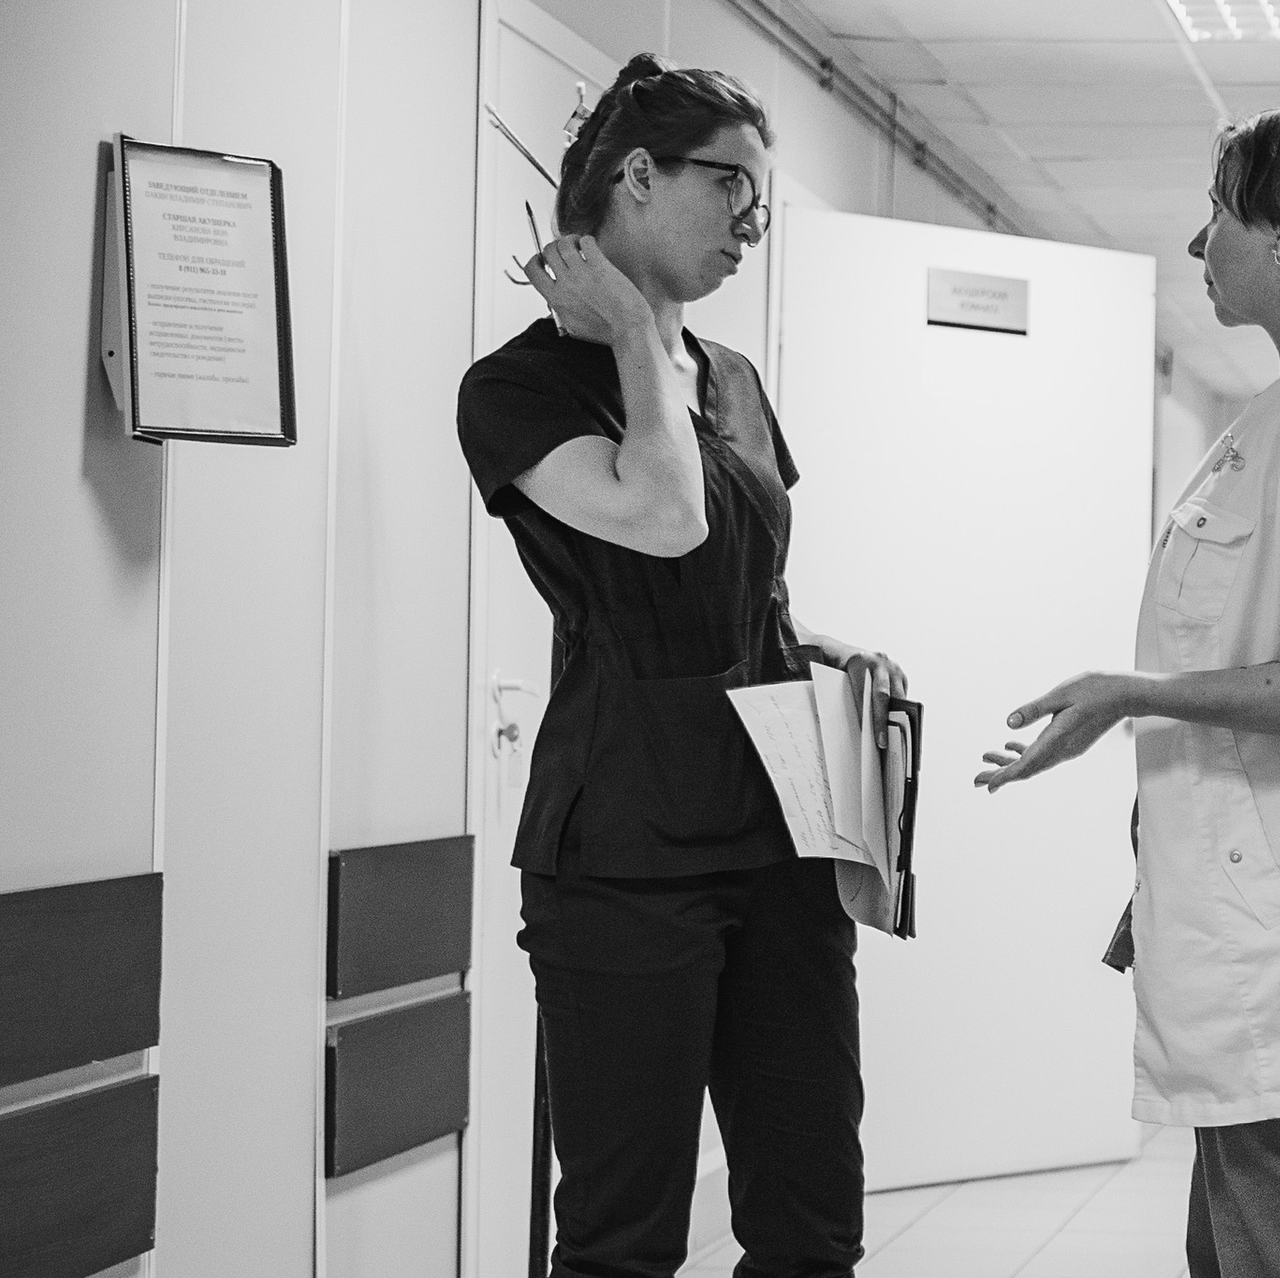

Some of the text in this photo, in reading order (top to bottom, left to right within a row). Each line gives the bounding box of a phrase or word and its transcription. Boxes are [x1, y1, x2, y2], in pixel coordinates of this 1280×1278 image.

[148, 181, 247, 200] ЗАВЕДУЮЩИЙ ОТДЕЛЕНИЕМ
[163, 213, 236, 228] СТАРШАЯ АКУШЕРКА
[173, 233, 228, 246] ВЛАДИМИРОВНА
[158, 252, 190, 263] ТЕЛЕФОН
[191, 256, 204, 265] ДЛЯ
